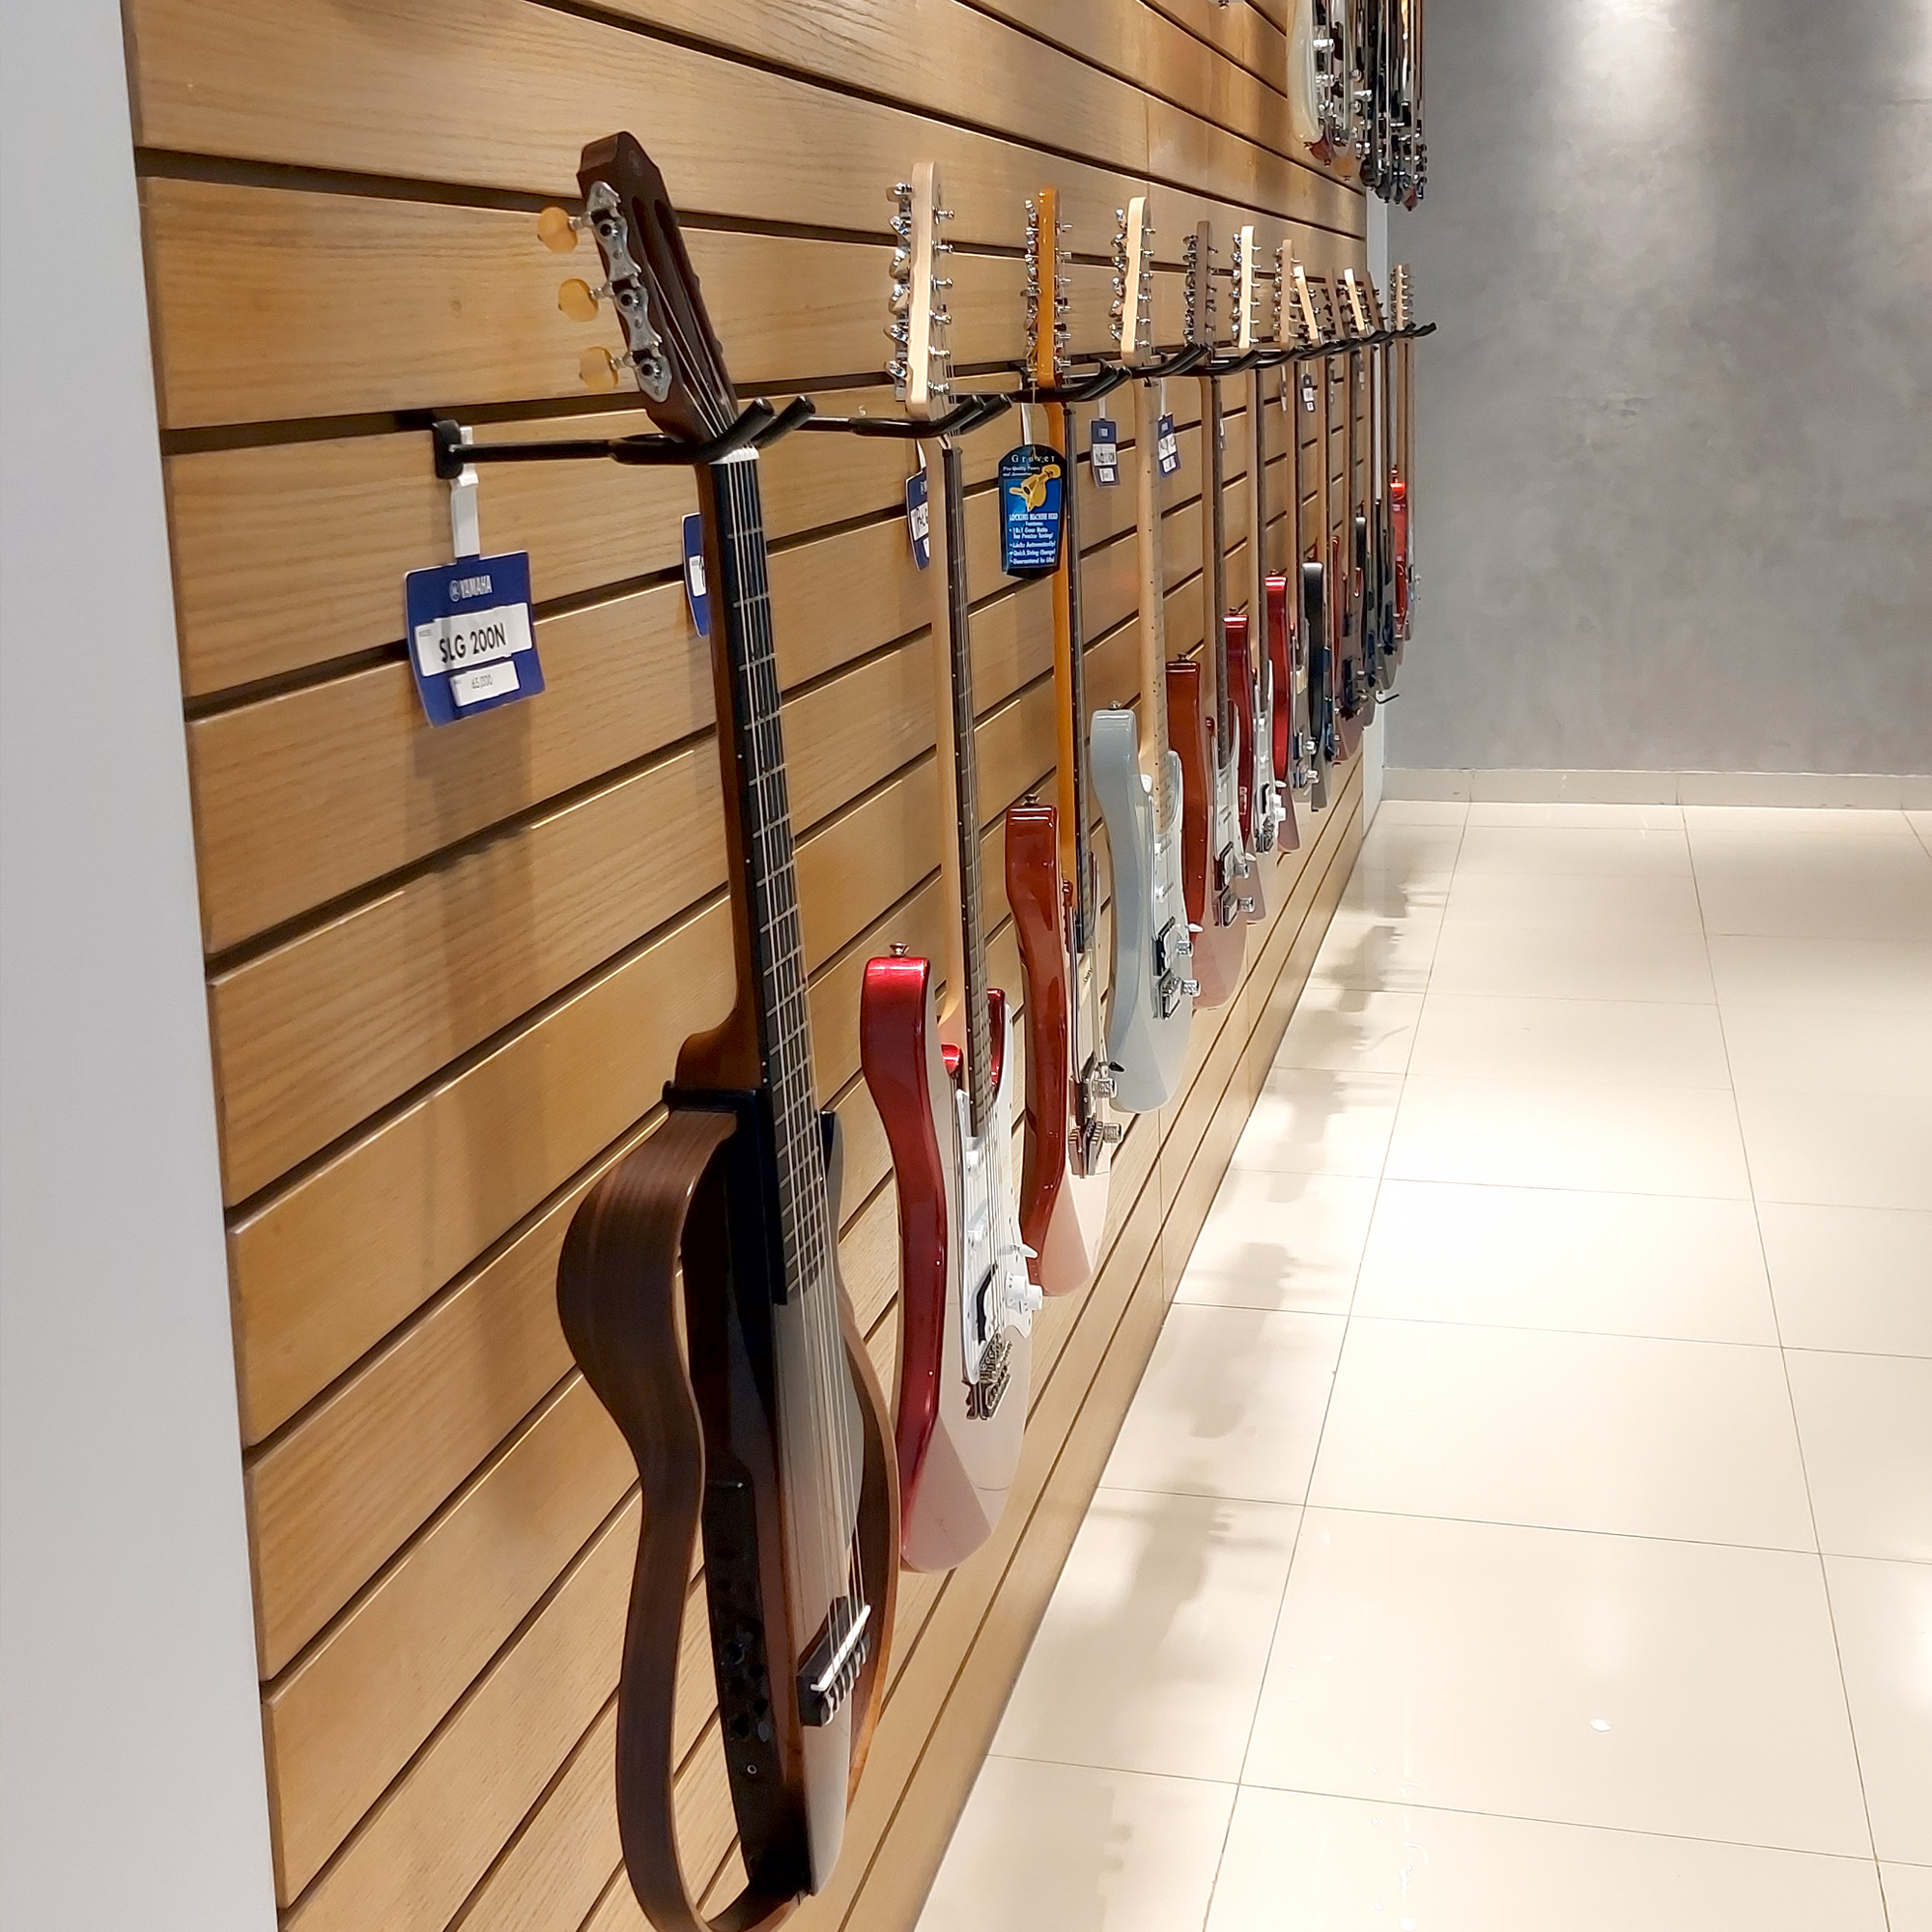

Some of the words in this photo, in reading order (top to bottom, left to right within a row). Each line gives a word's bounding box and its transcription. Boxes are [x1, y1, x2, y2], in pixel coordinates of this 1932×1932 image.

[1011, 454, 1056, 464] Grover
[439, 635, 467, 664] SLG
[469, 622, 506, 655] 200N
